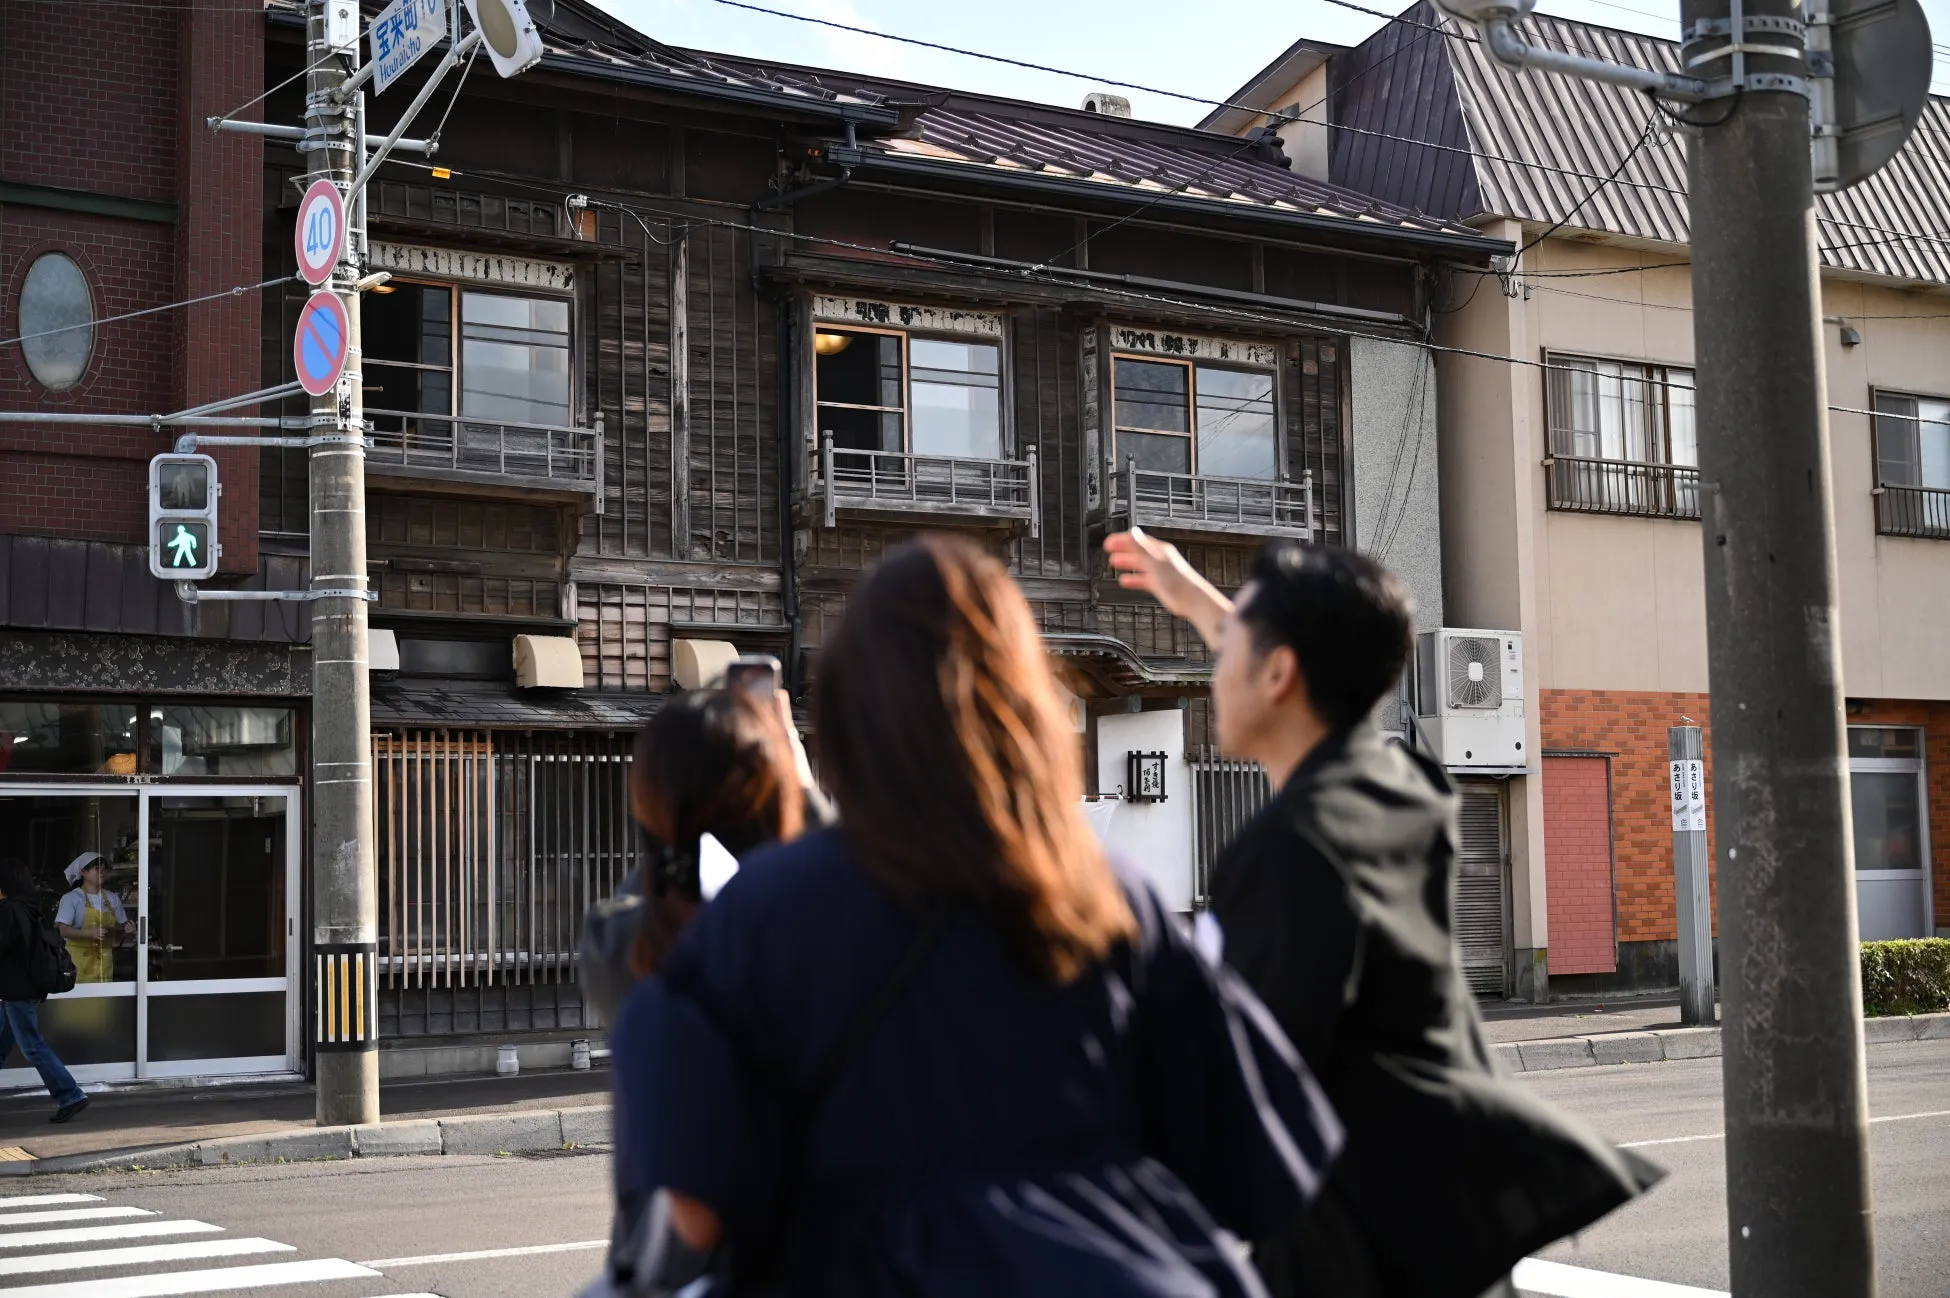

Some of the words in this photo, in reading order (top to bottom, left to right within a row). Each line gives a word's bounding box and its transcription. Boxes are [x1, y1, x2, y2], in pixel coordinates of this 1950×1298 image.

[307, 207, 332, 256] 40
[1673, 763, 1683, 801] あさり坂
[1690, 763, 1699, 801] あさり坂
